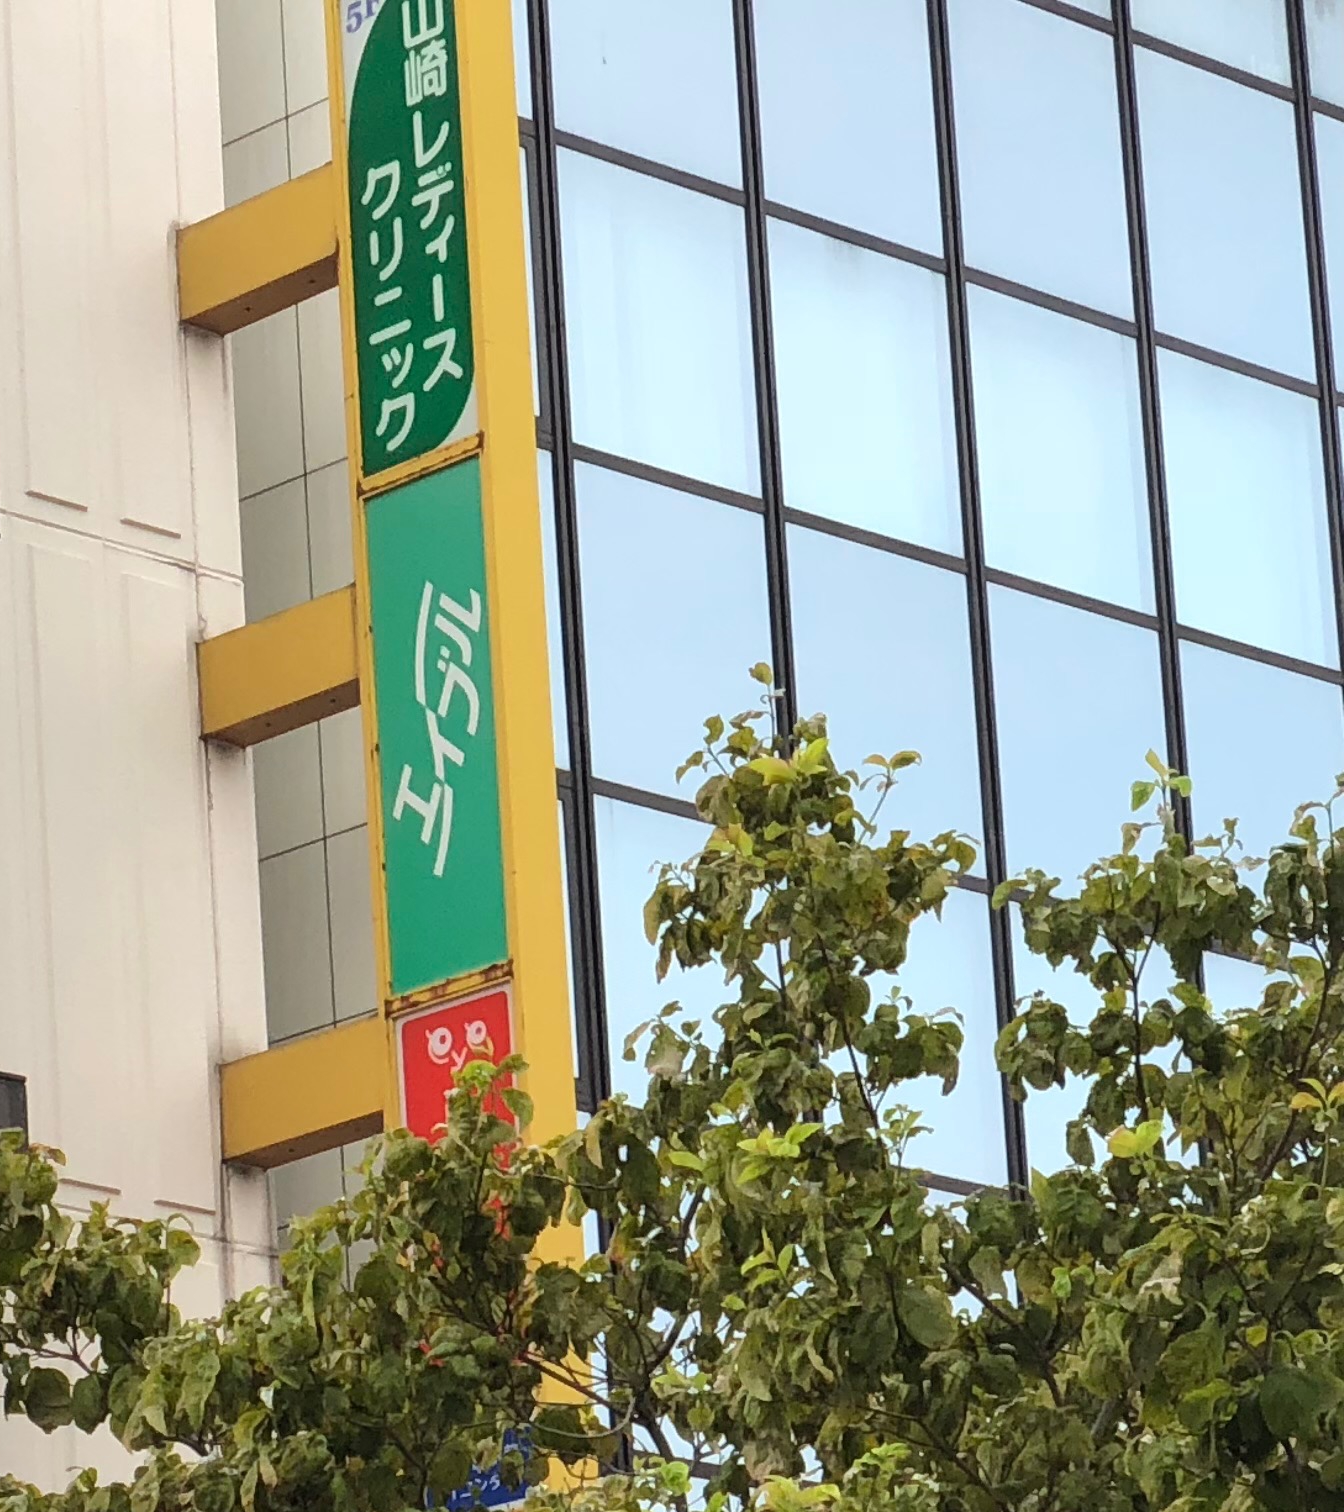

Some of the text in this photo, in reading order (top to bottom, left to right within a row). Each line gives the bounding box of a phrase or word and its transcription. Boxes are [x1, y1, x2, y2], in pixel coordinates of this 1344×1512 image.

[361, 158, 416, 453] クリニック
[392, 580, 481, 877] エイブル
